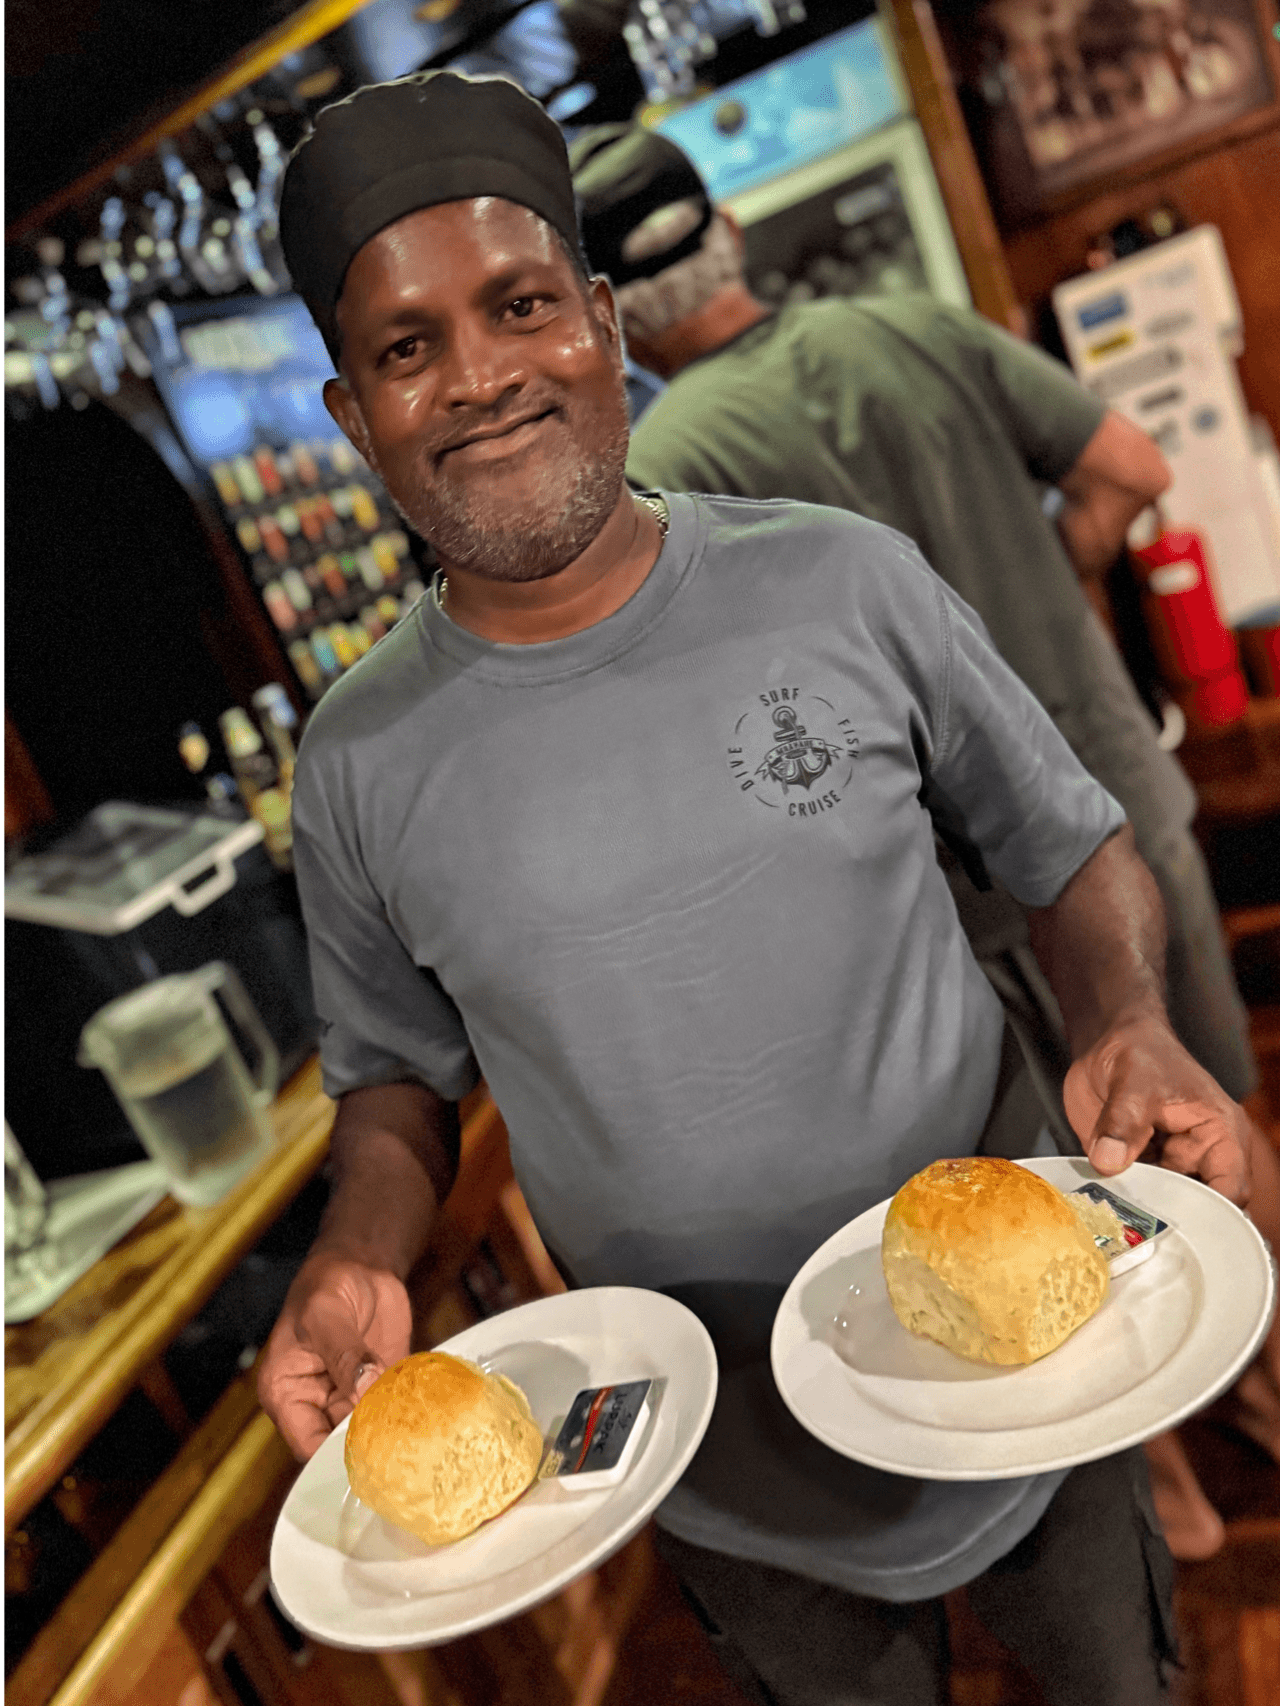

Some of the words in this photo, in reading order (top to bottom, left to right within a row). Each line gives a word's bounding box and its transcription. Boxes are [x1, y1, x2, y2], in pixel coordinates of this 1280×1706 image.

[759, 688, 800, 707] SURF
[837, 718, 860, 758] FISH
[728, 747, 754, 791] DIVE
[788, 790, 841, 817] CRUISE
